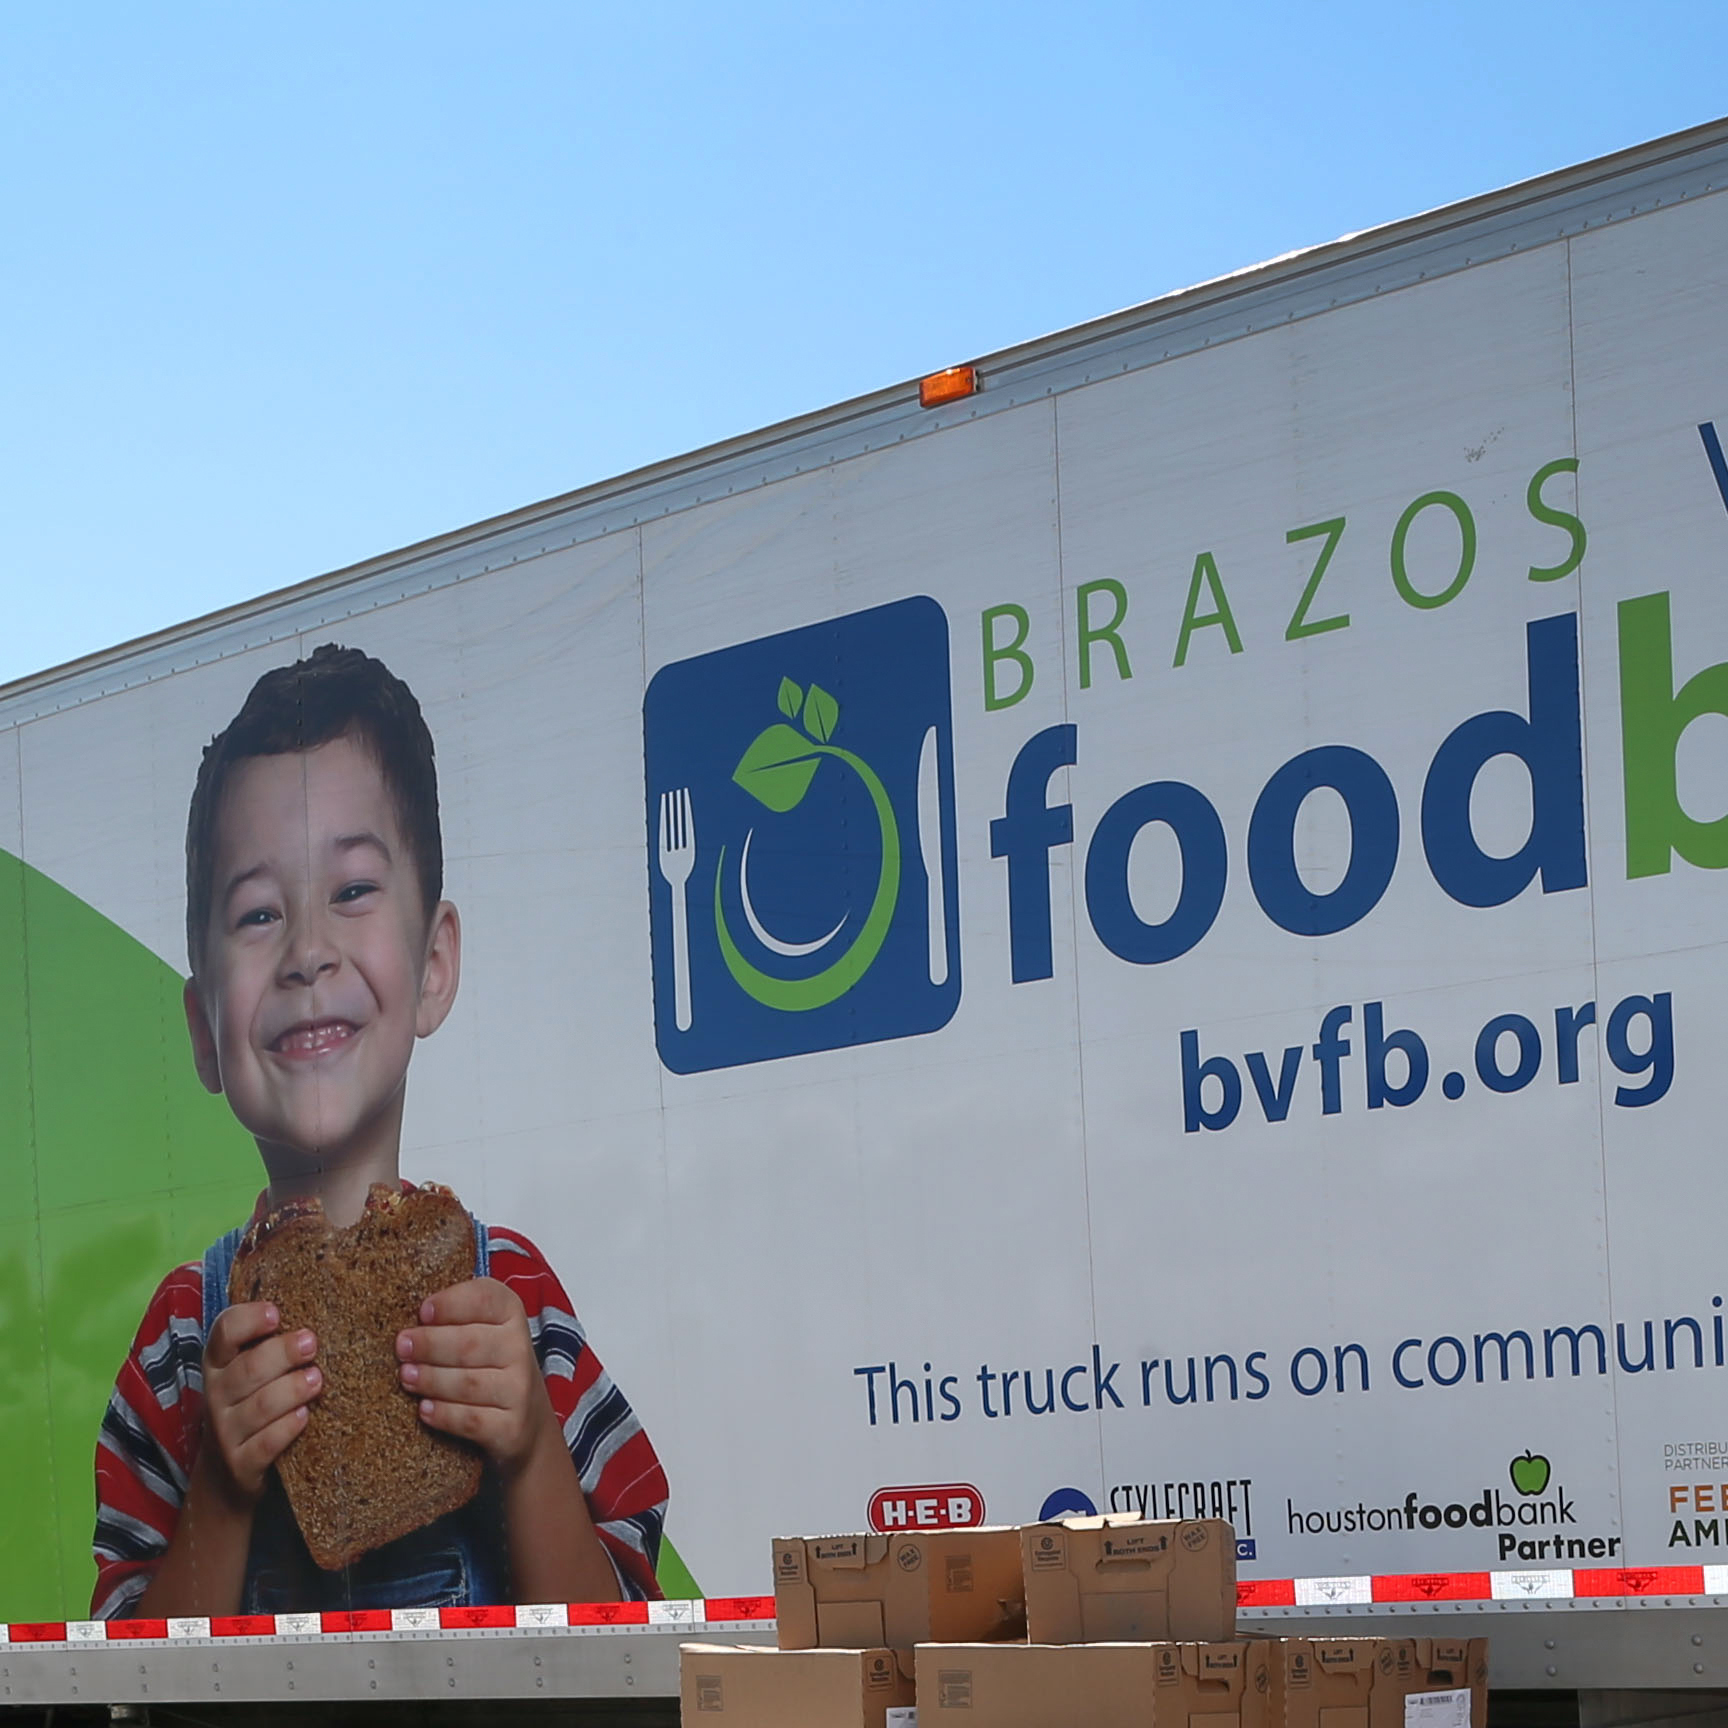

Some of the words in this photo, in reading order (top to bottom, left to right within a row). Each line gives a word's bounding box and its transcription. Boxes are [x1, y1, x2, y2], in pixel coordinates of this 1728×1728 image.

[981, 457, 1588, 712] BRAZOS
[1179, 990, 1676, 1134] bvfb.org
[852, 1361, 962, 1427] This
[975, 1343, 1125, 1419] truck
[1140, 1349, 1271, 1408] runs
[1289, 1341, 1371, 1397] on
[1497, 1533, 1622, 1562] Partner
